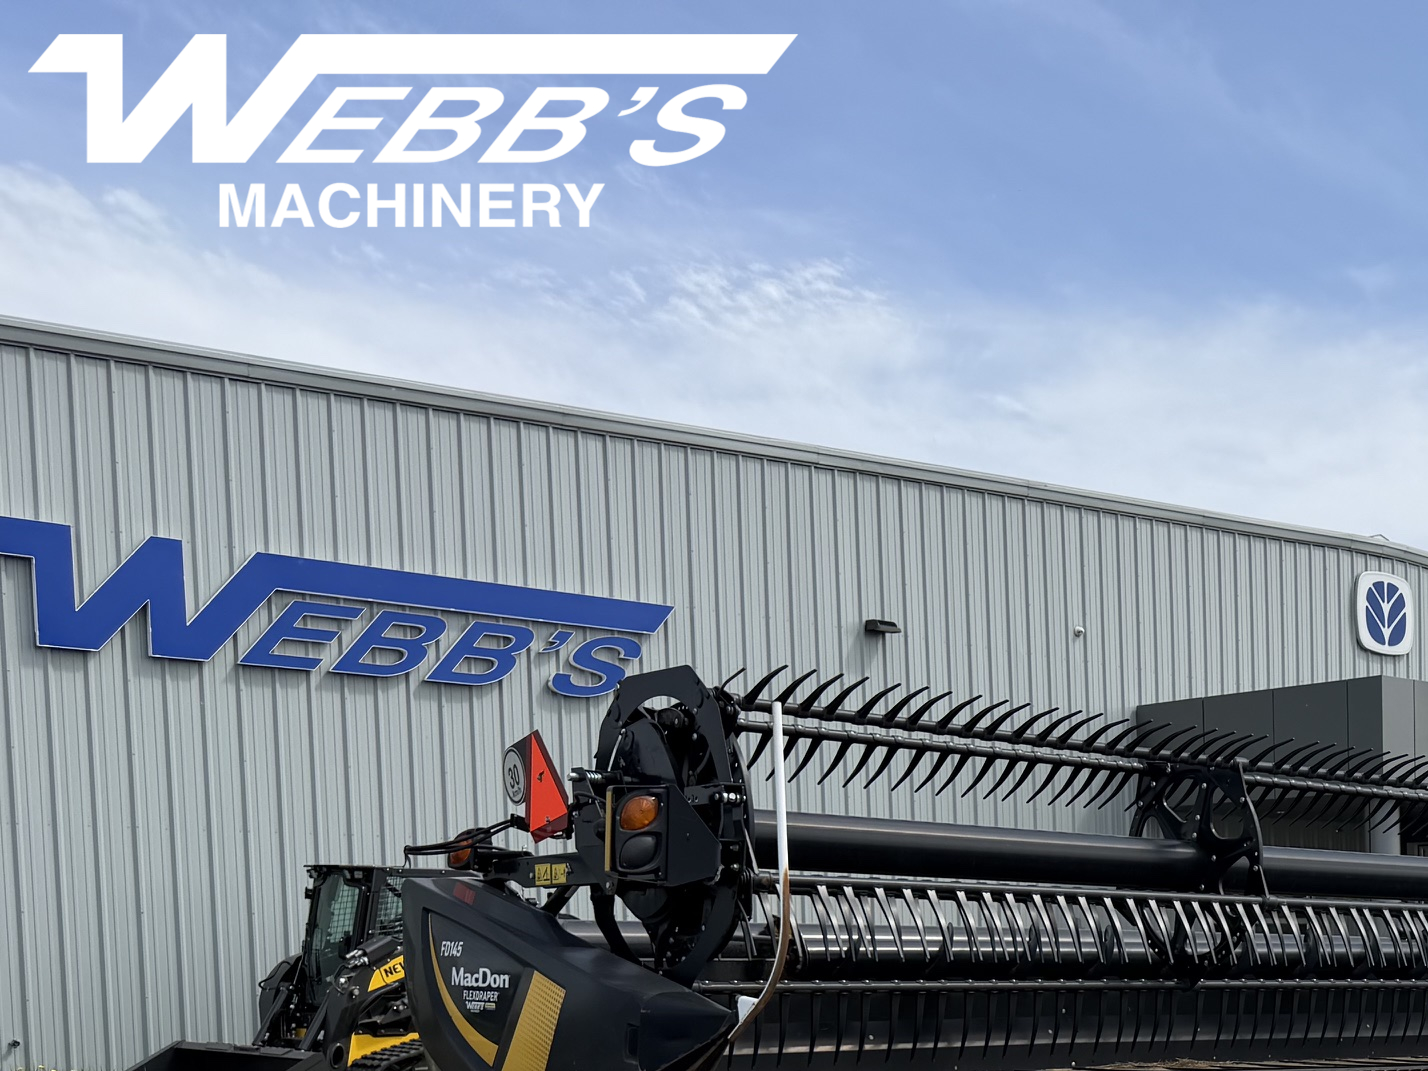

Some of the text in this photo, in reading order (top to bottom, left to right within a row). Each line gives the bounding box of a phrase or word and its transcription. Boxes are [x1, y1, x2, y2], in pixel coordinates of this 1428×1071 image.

[0, 515, 675, 698] WEBB'S
[508, 764, 520, 789] 30
[440, 941, 463, 957] FD145
[451, 966, 509, 988] MacDon
[462, 990, 498, 1001] FLEXDRAPER
